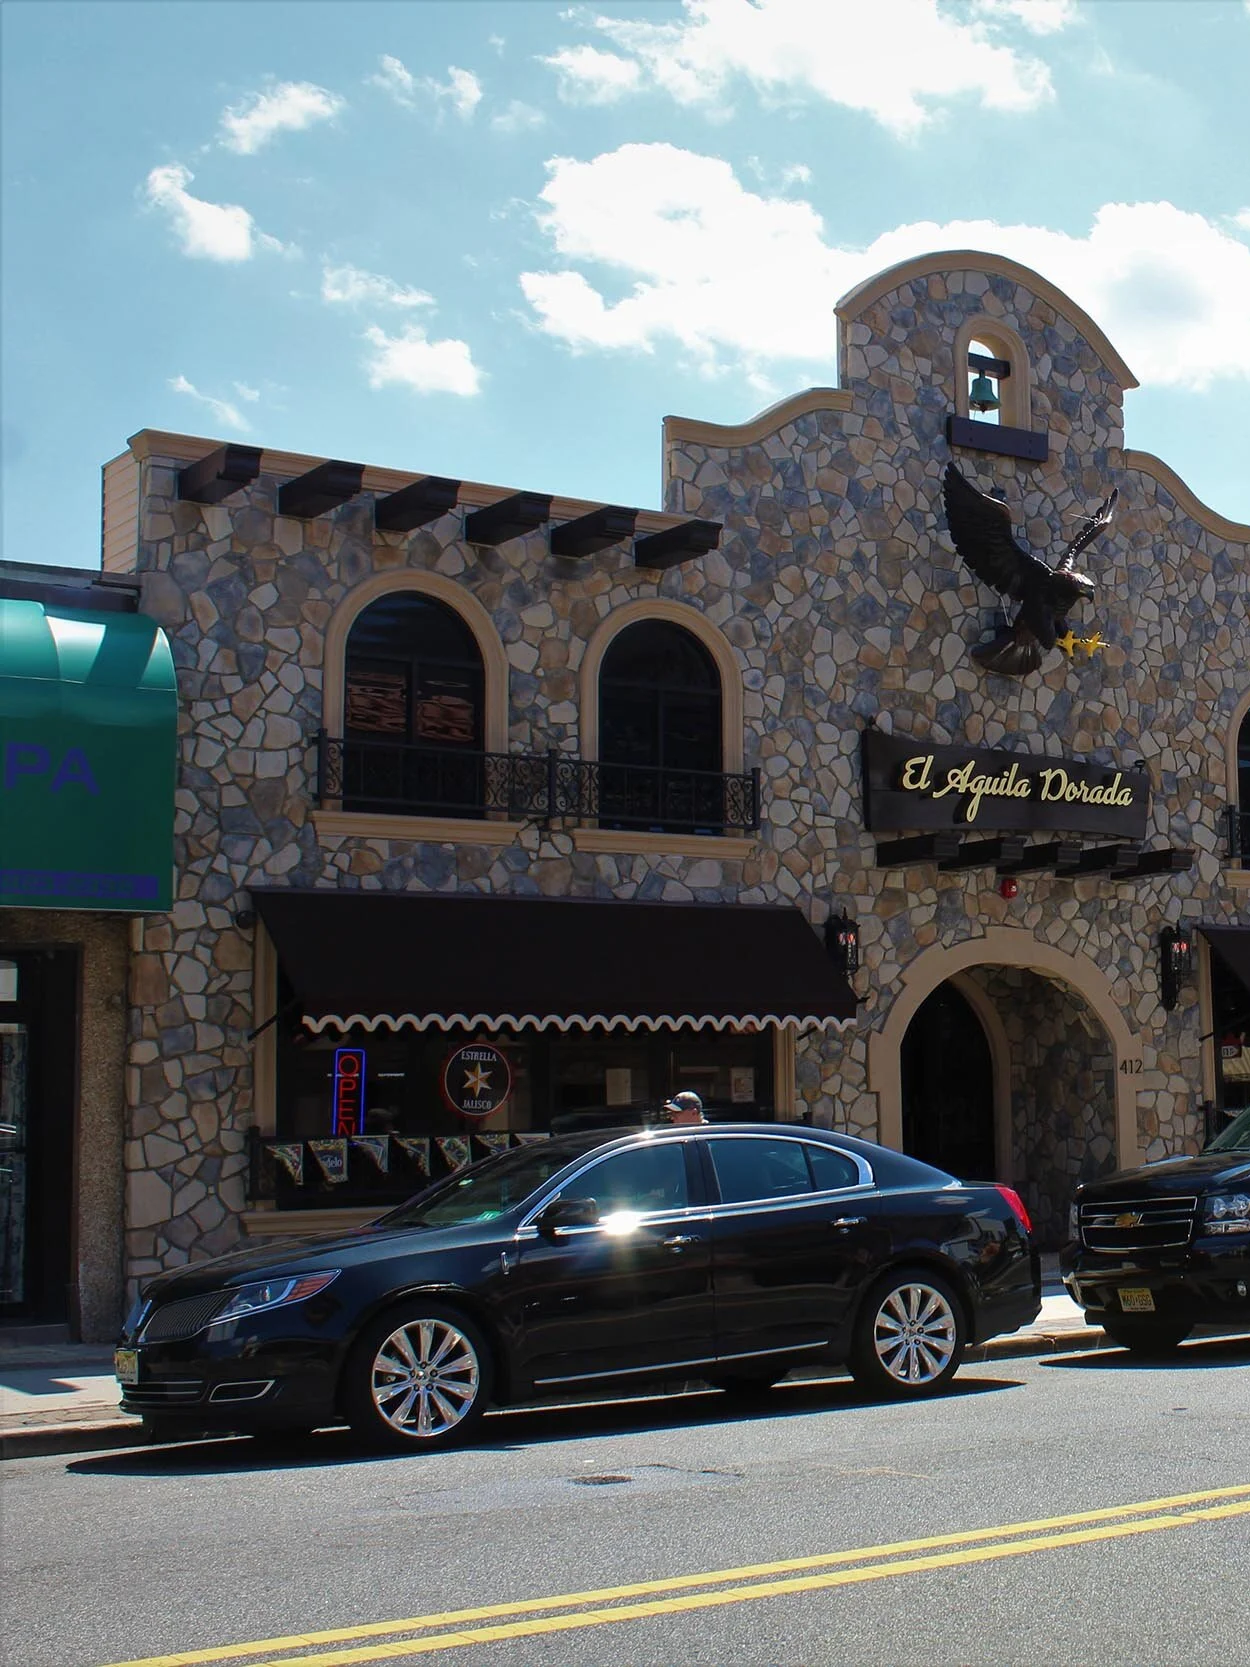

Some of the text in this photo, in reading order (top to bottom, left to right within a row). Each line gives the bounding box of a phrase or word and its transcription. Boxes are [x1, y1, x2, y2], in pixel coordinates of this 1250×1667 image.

[902, 755, 1133, 822] El Aguila Dorada
[461, 1051, 497, 1062] ESTRELLA
[1120, 1060, 1143, 1074] 412
[338, 1055, 360, 1137] OPEN
[462, 1099, 492, 1110] JALISCO
